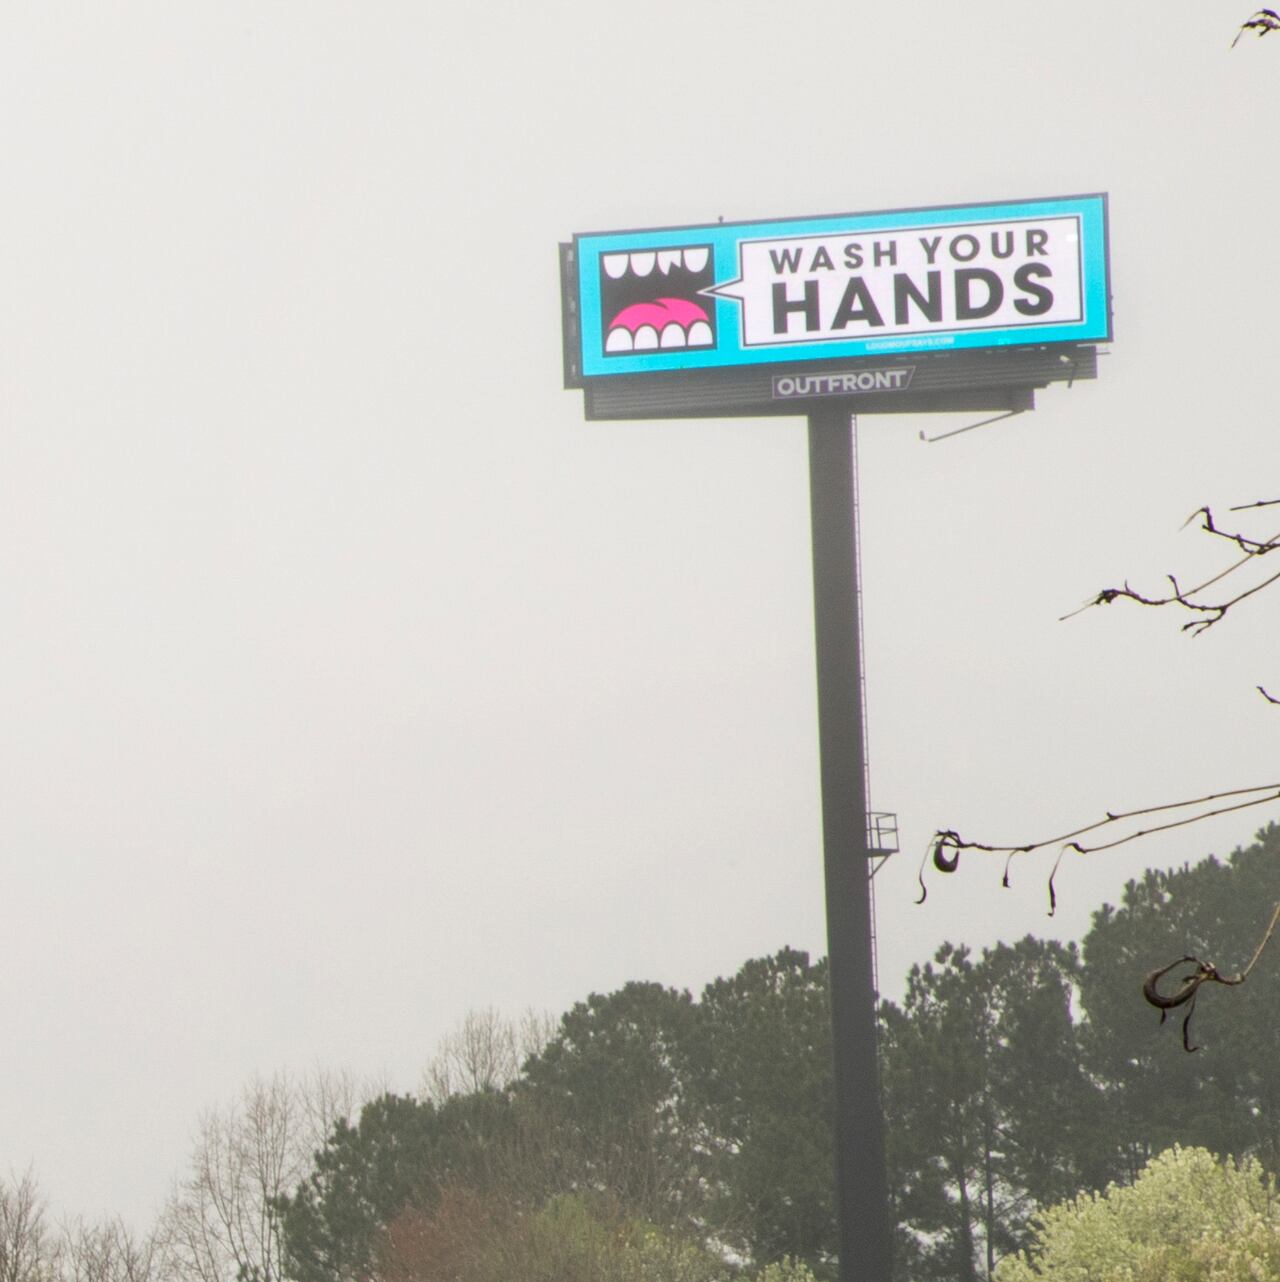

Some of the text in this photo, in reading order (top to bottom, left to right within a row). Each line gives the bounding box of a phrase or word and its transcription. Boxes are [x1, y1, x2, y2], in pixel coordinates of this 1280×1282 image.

[768, 228, 1050, 276] WASH YOUR
[771, 261, 1055, 336] HANDS
[776, 370, 908, 396] OUTFRONT
